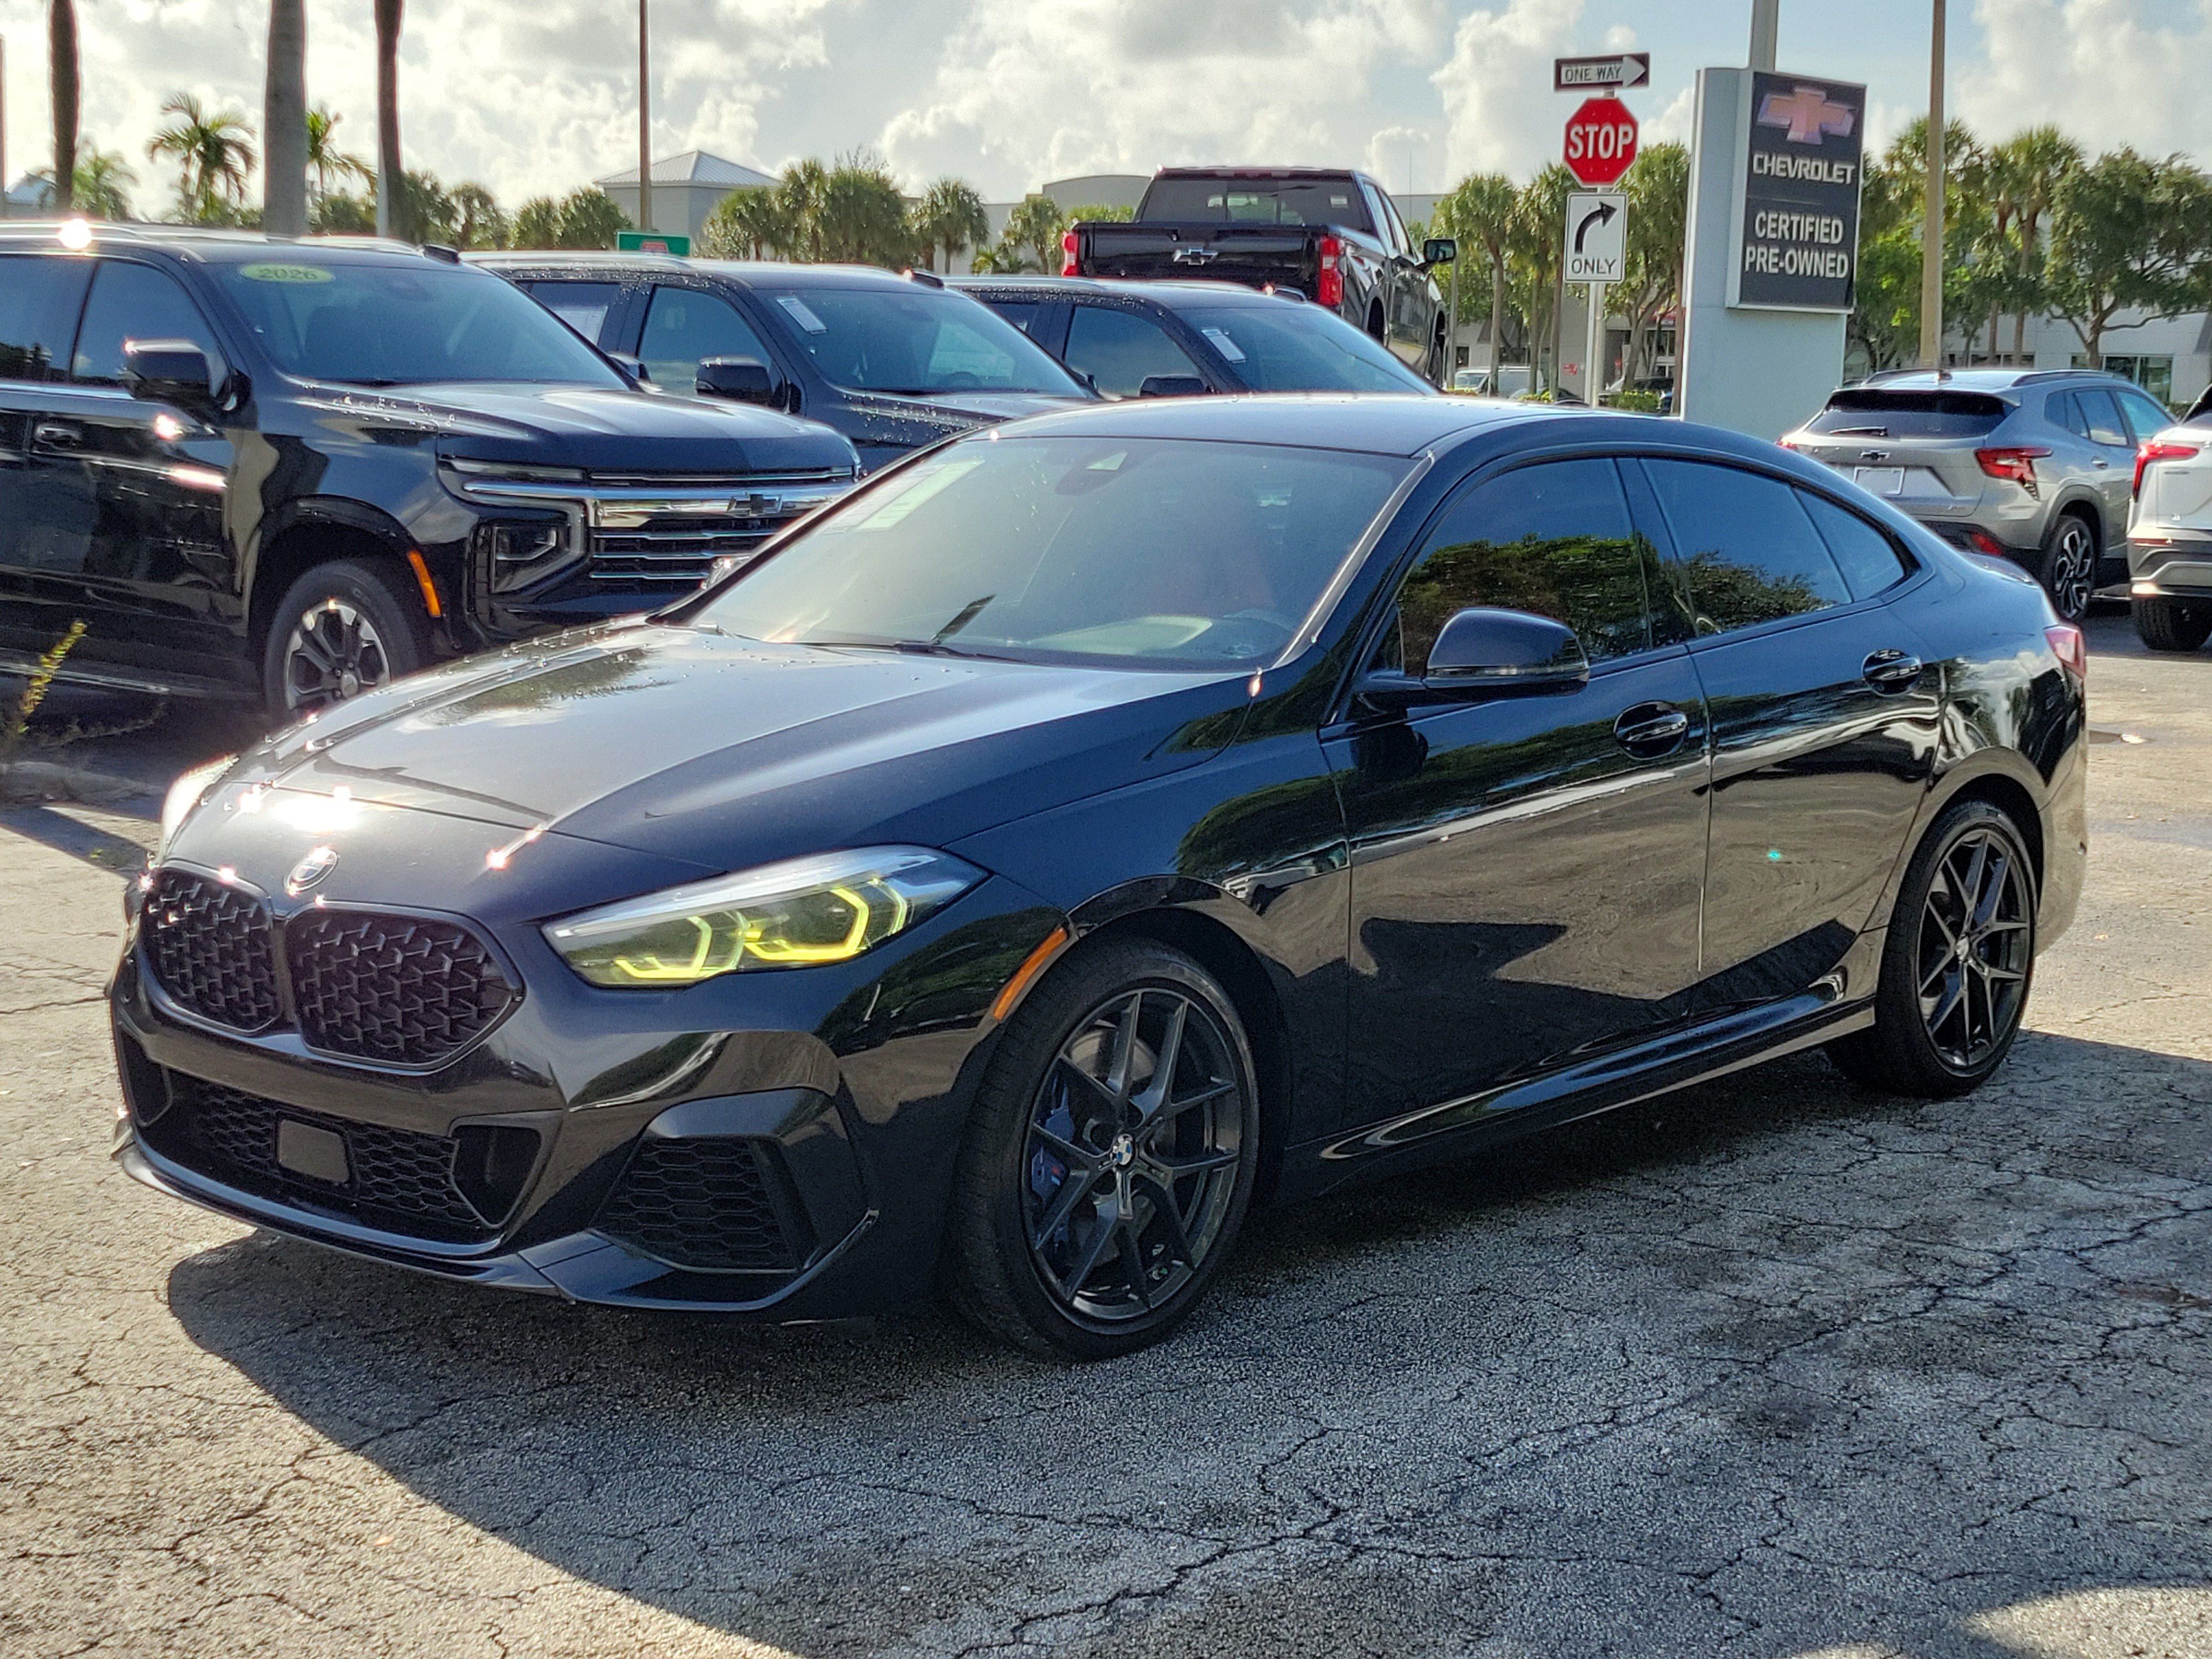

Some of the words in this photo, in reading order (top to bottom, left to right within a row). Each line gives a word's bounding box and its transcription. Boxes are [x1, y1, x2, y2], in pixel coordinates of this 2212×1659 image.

[1565, 67, 1592, 82] ONE
[1597, 65, 1622, 80] WAY
[1568, 123, 1634, 159] STOP
[1753, 154, 1855, 184] CHEVROLET
[1755, 211, 1844, 244] CERTIFIED
[1571, 258, 1617, 274] ONLY
[1745, 246, 1849, 278] PRE-OWNED
